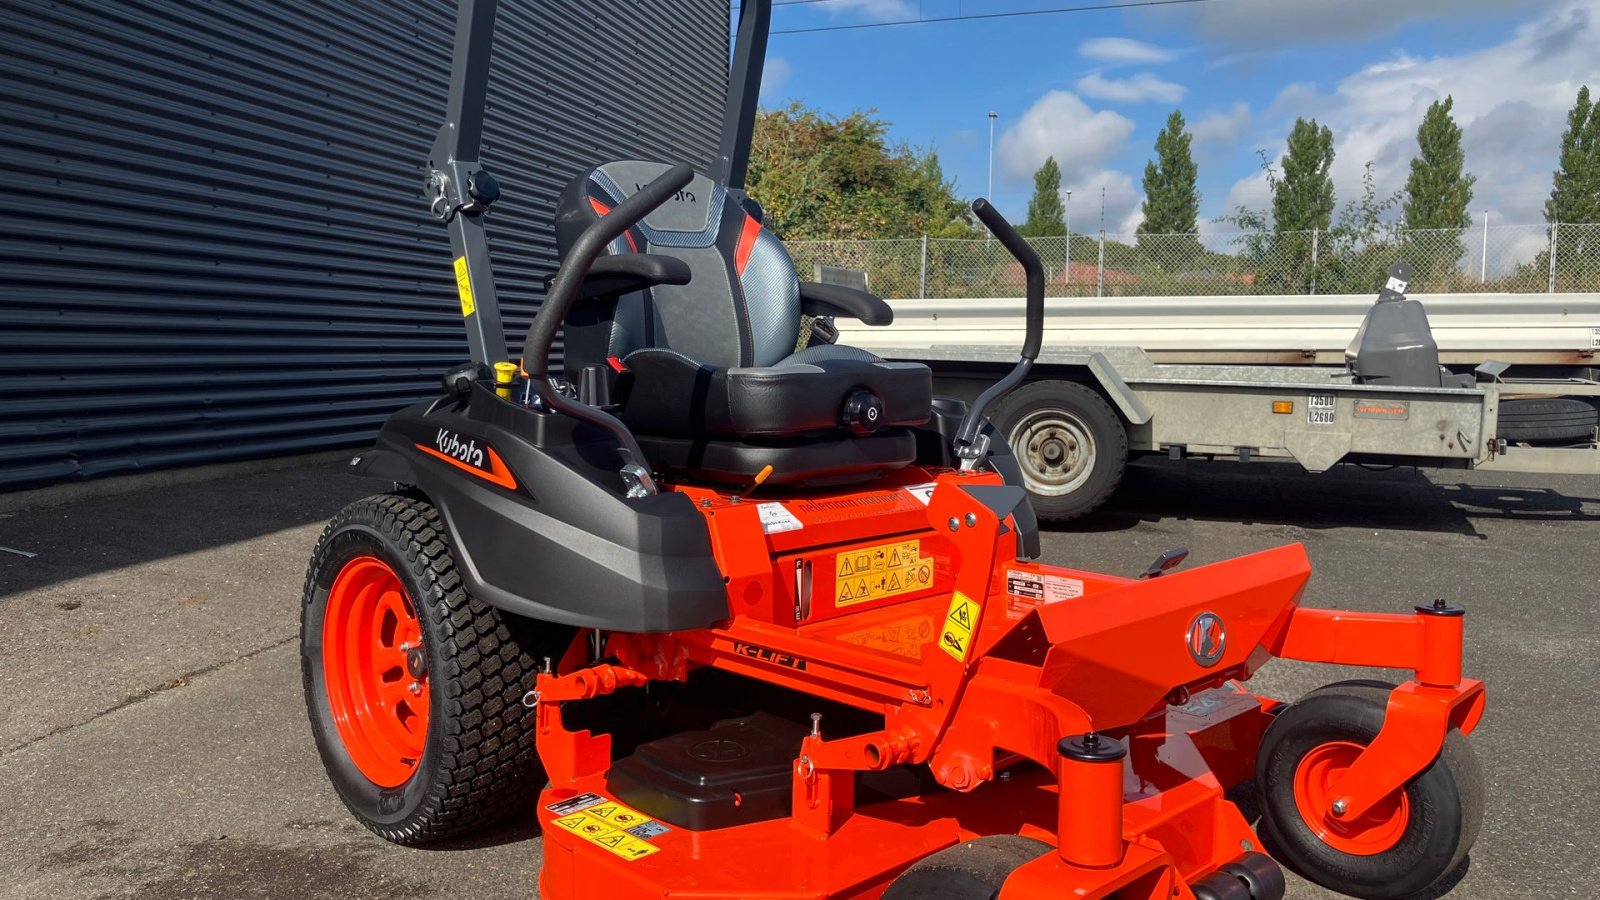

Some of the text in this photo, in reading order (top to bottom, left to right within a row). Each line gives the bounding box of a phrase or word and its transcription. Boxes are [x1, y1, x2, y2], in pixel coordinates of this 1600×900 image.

[1309, 394, 1334, 406] T3500
[1309, 411, 1334, 423] L2680
[436, 427, 484, 467] Kubota
[736, 643, 804, 668] K-LIFT
